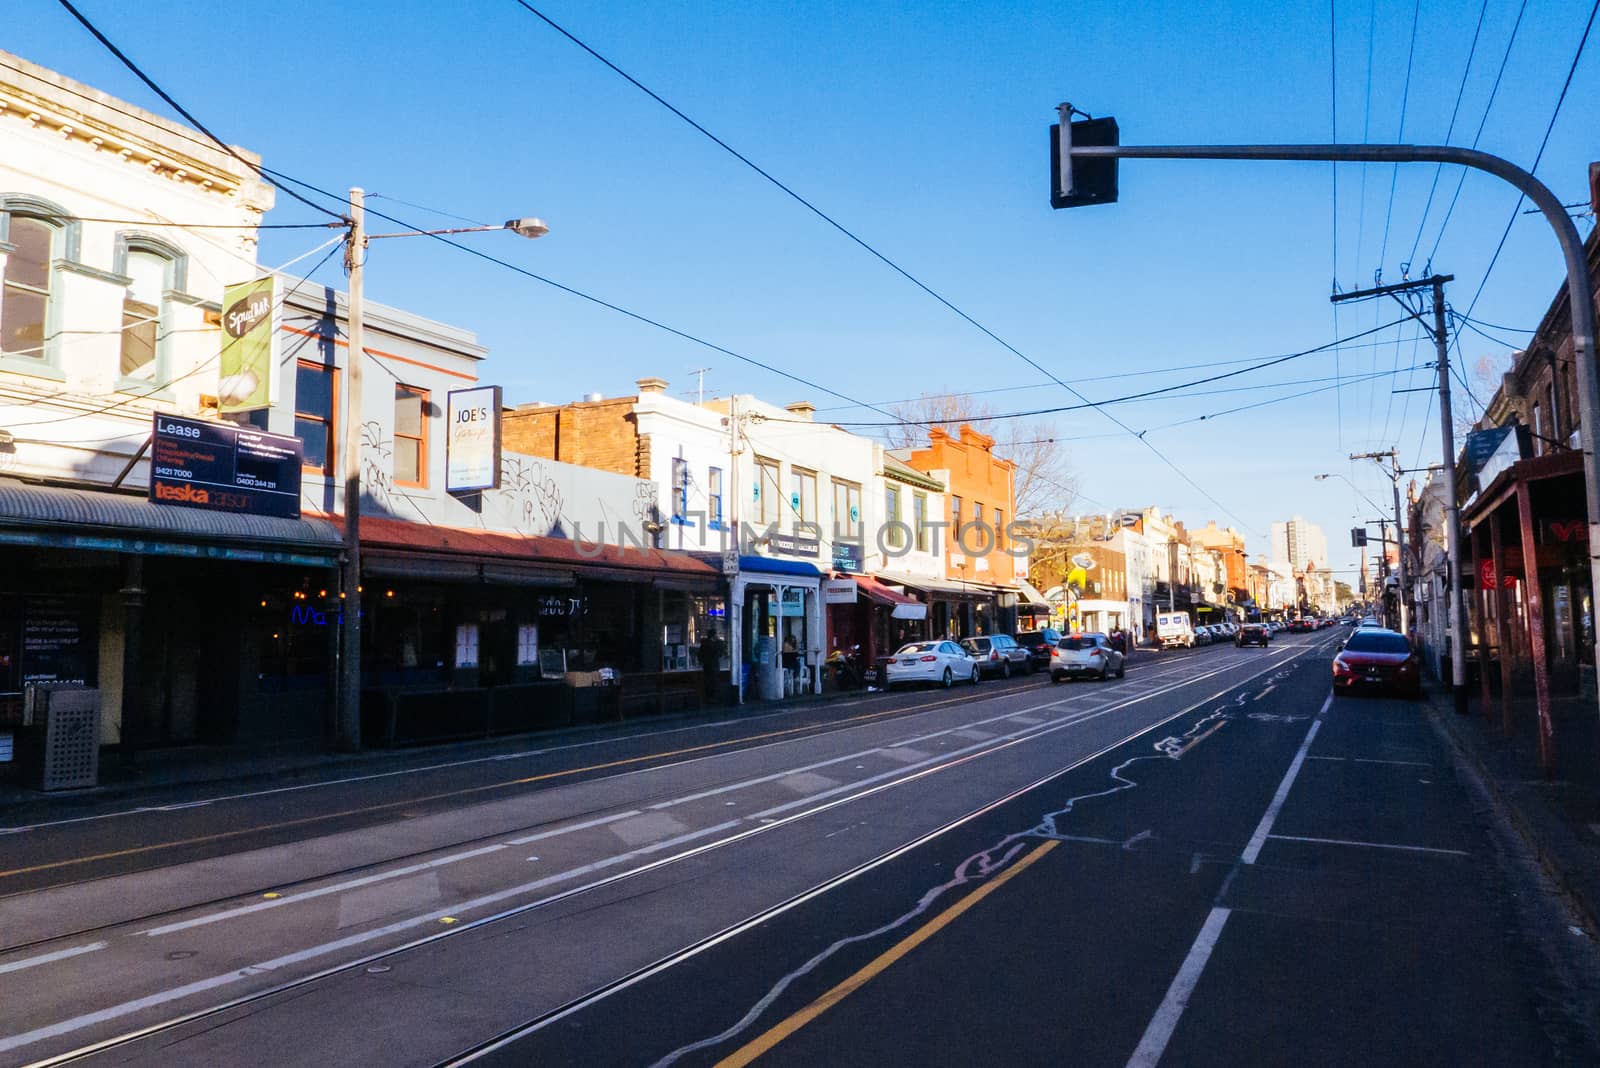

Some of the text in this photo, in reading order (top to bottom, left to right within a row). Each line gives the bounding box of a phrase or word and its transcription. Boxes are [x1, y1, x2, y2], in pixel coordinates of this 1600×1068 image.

[456, 407, 487, 424] JOE'S
[157, 418, 201, 438] Lease
[155, 466, 193, 479] 9421 7000
[236, 477, 255, 487] 0400
